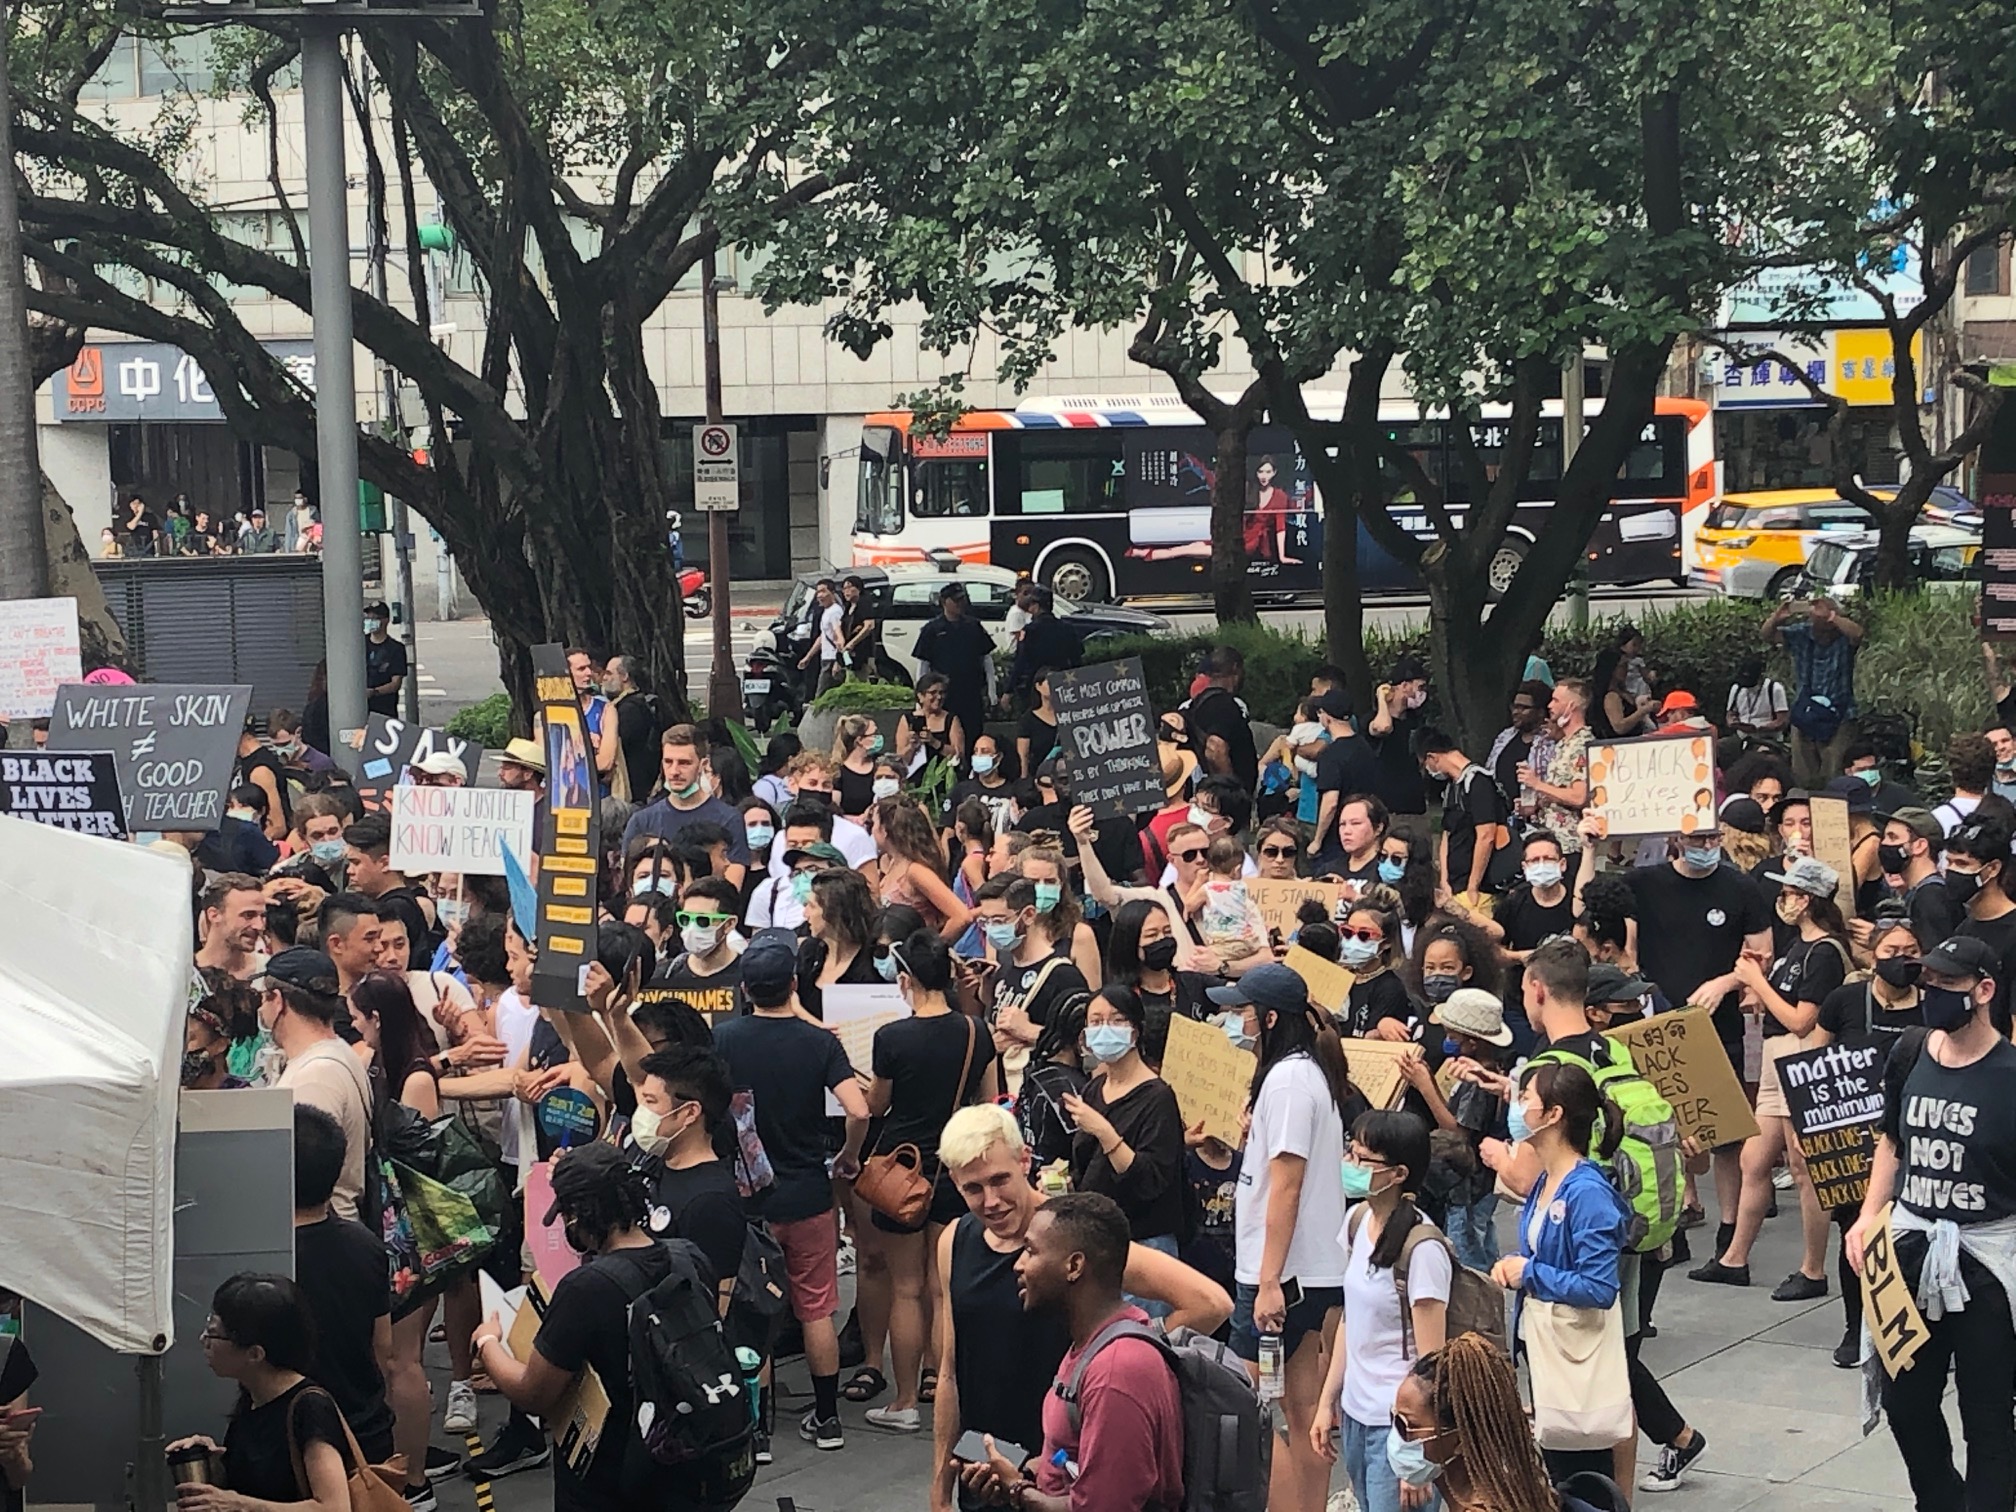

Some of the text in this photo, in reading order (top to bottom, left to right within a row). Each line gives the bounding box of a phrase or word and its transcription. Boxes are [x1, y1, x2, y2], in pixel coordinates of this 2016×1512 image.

[1055, 676, 1142, 704] THE MOST COMMON
[65, 694, 231, 729] WHITE SKIN
[1073, 712, 1152, 759] POWER
[2, 757, 95, 783] BLACK
[137, 760, 203, 788] GOOD
[1073, 769, 1085, 782] IS
[1087, 765, 1101, 780] BY
[1616, 745, 1691, 784] BLACK
[10, 786, 92, 809] LIVES
[144, 790, 218, 820] TEACHER
[398, 788, 457, 818] KNOW
[1077, 790, 1099, 804] THEY
[1604, 802, 1691, 822] matter
[396, 823, 455, 857] KNOW
[1279, 888, 1326, 904] STAND
[1786, 1044, 1877, 1088] matter
[1809, 1075, 1869, 1104] is the
[1803, 1092, 1884, 1127] minimum
[1906, 1095, 1978, 1136] LIVES
[1802, 1132, 1832, 1158] BLACK
[1910, 1136, 1965, 1173] NOT
[1808, 1157, 1840, 1184] BLACK
[1864, 1225, 1918, 1362] BLM
